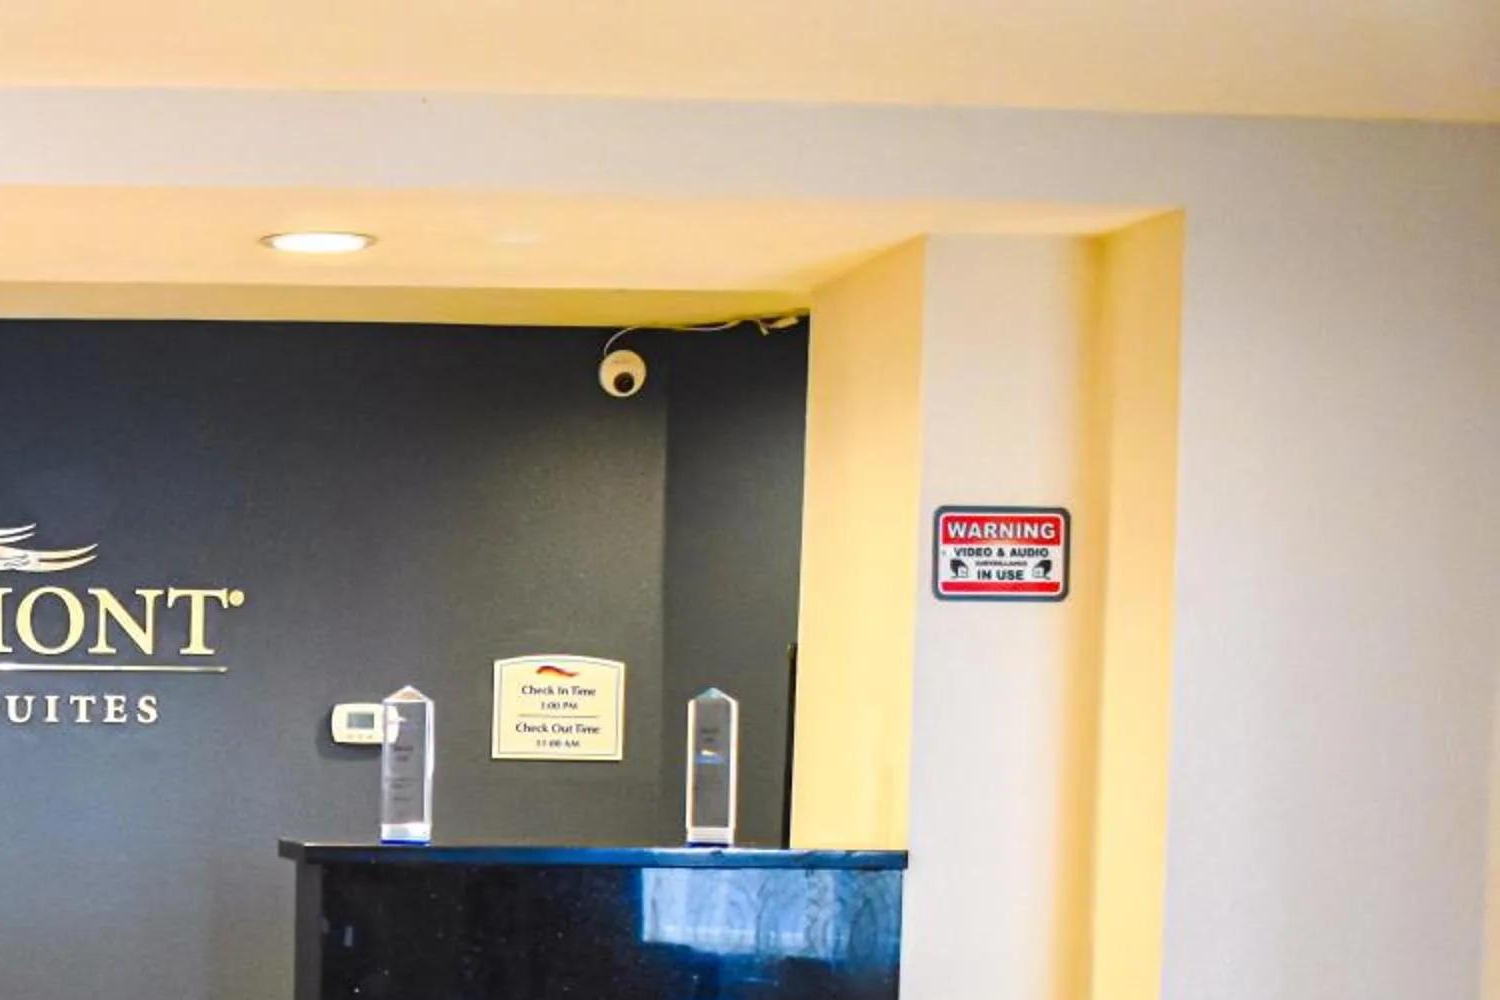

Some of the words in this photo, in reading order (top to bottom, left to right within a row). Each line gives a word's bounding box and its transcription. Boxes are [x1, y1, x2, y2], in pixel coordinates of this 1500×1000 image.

[947, 521, 1056, 540] WARNING
[954, 547, 993, 558] VIDEO
[996, 547, 1006, 558] &
[1009, 547, 1050, 558] AUDIO
[977, 569, 992, 580] IN
[996, 569, 1025, 580] USE
[521, 685, 554, 696] Check
[557, 686, 569, 696] In
[571, 685, 597, 696] Time
[562, 701, 579, 710] PM
[515, 723, 549, 733] Check
[551, 723, 573, 733] Out
[575, 723, 601, 734] Time
[564, 739, 580, 748] AM
